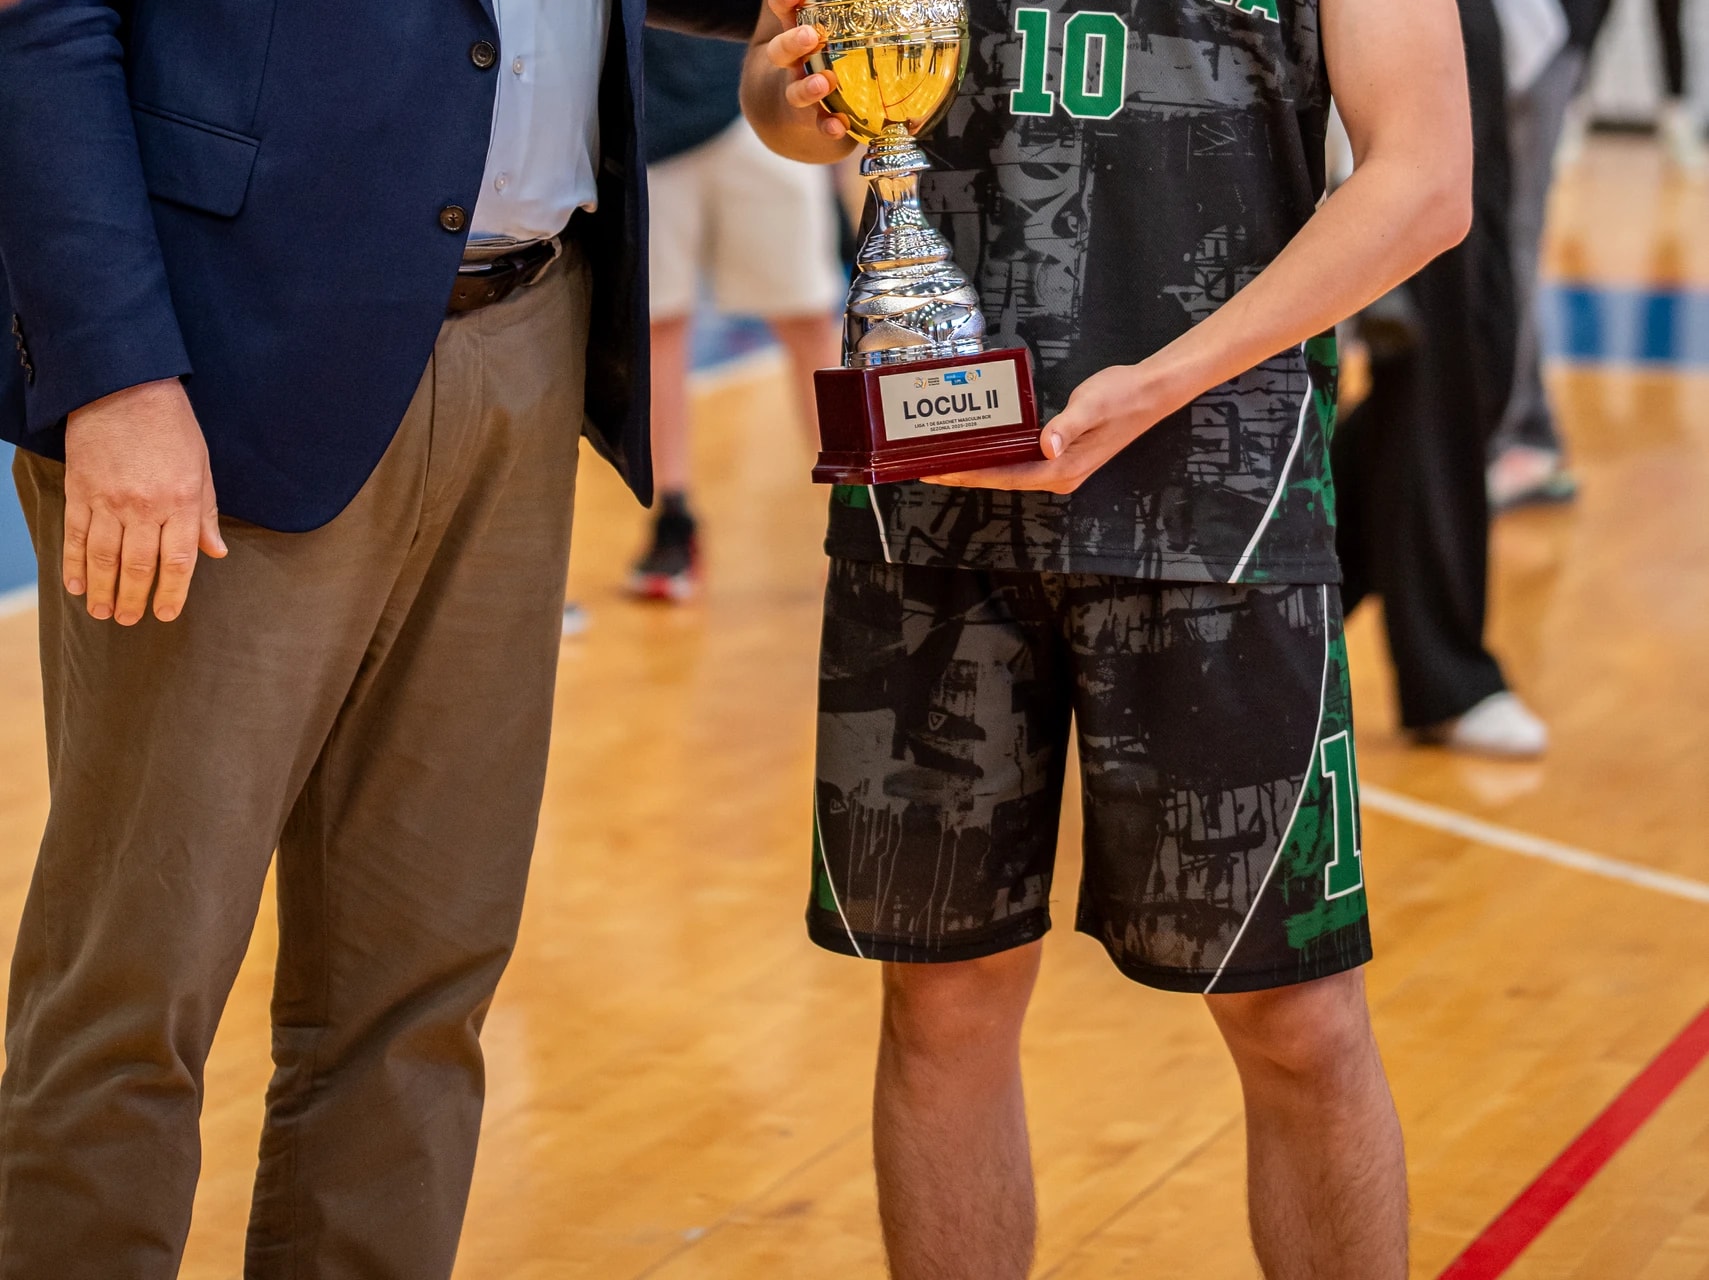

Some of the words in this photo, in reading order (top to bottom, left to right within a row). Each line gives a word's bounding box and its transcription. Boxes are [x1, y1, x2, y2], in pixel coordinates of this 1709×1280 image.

[1009, 8, 1128, 120] 10
[903, 393, 981, 419] LOCUL
[986, 389, 999, 409] II
